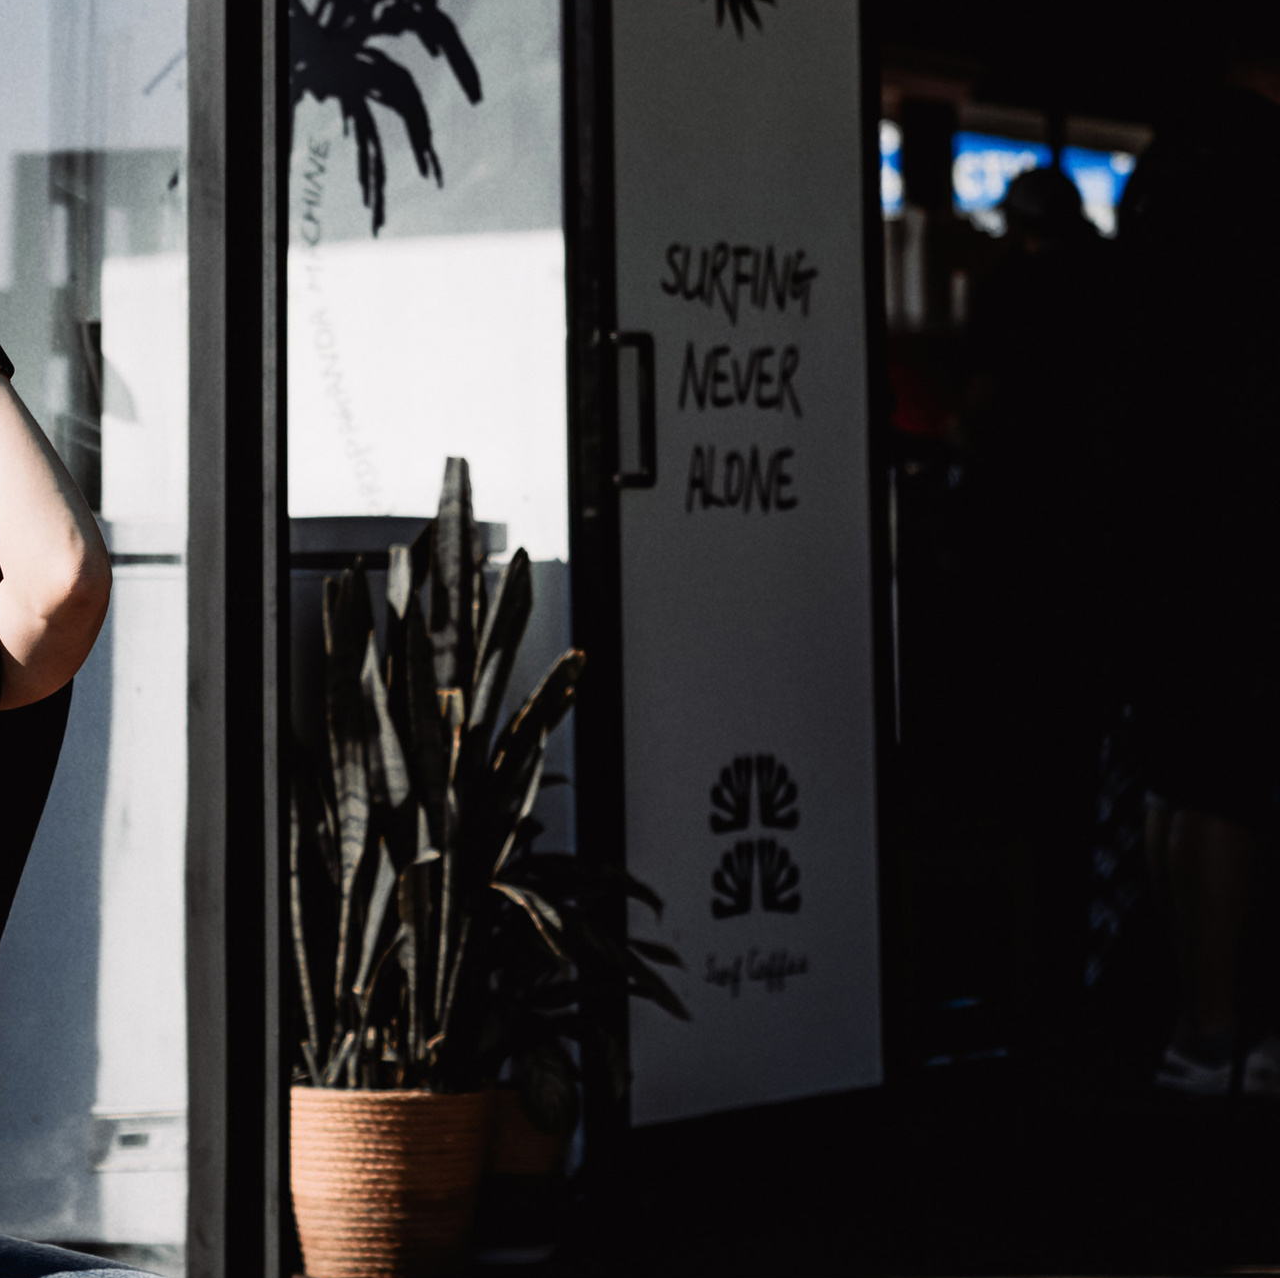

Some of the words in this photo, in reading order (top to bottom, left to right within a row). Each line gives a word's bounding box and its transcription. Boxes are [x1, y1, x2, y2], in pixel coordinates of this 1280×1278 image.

[661, 240, 819, 326] SURFING
[678, 340, 803, 419] NEVER
[685, 442, 800, 515] ALONE
